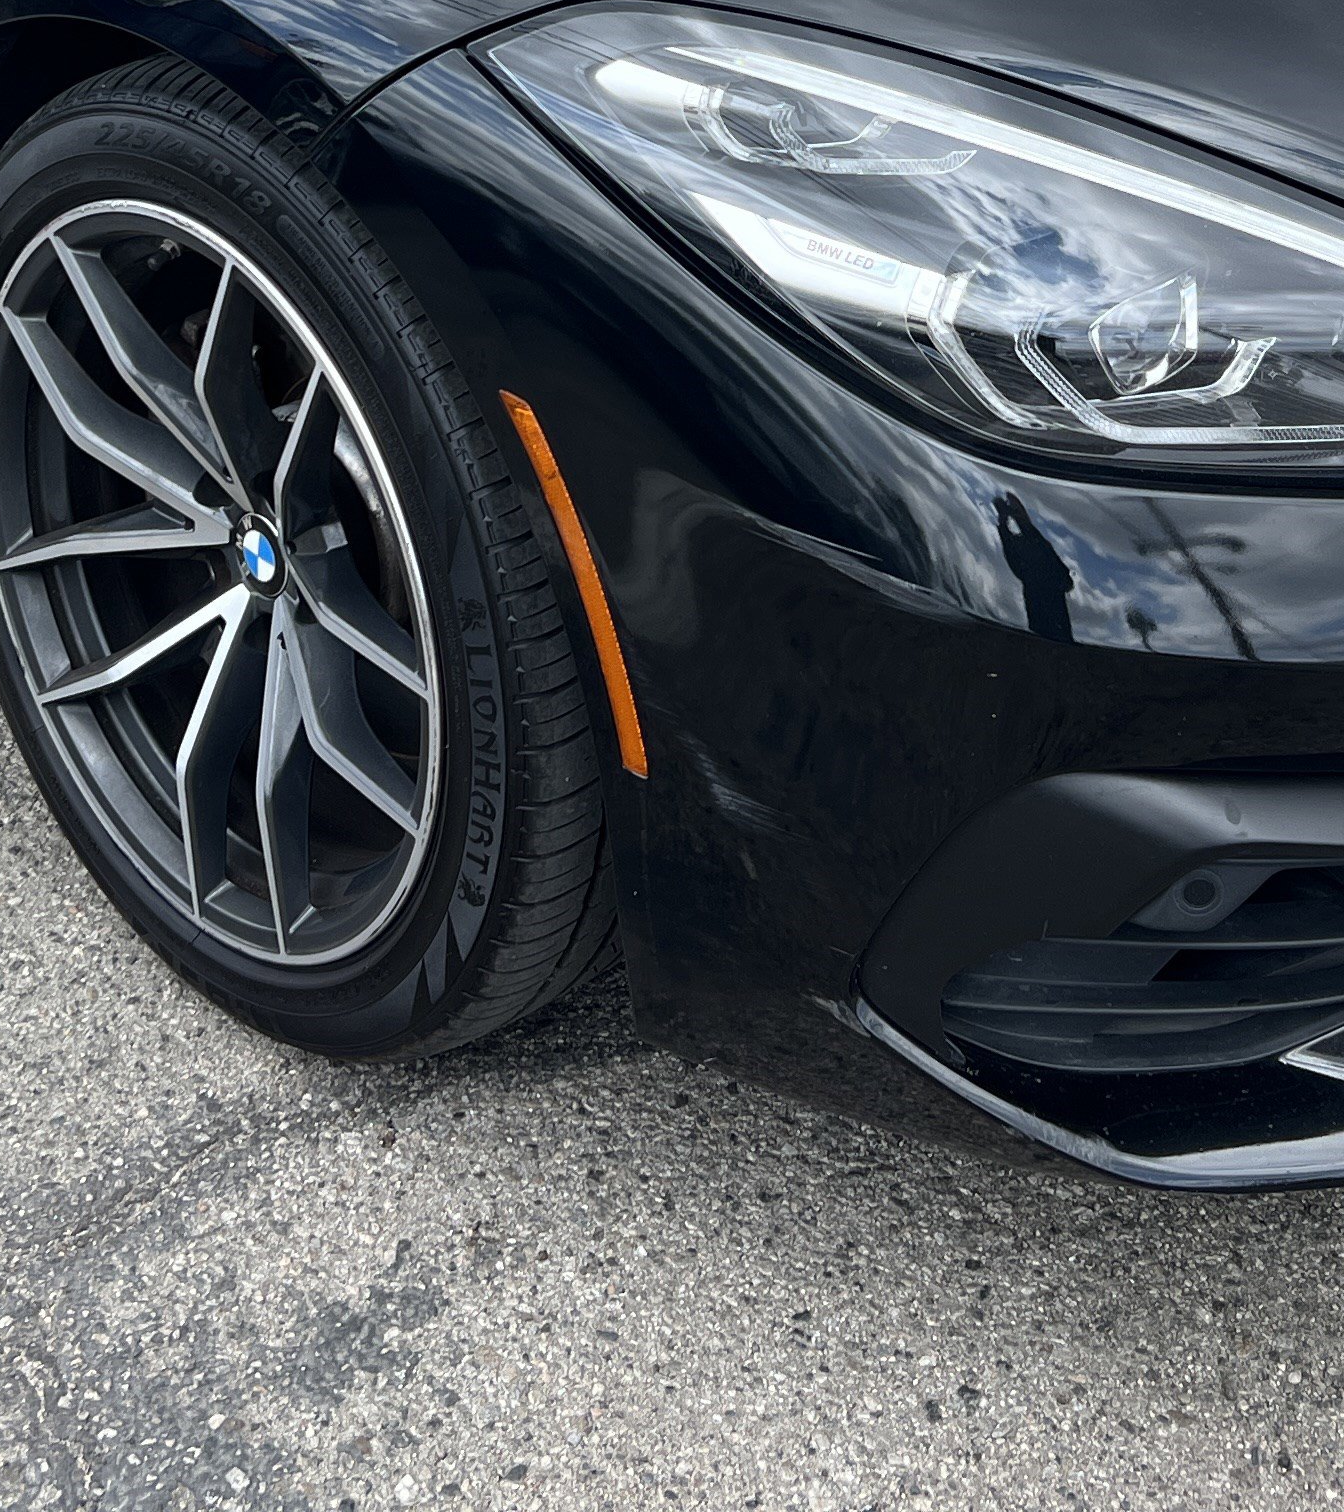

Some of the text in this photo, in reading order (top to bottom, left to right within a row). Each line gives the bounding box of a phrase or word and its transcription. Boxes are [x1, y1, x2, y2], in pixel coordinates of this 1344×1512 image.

[807, 239, 874, 270] BMW LED
[464, 643, 502, 876] LIONHART
